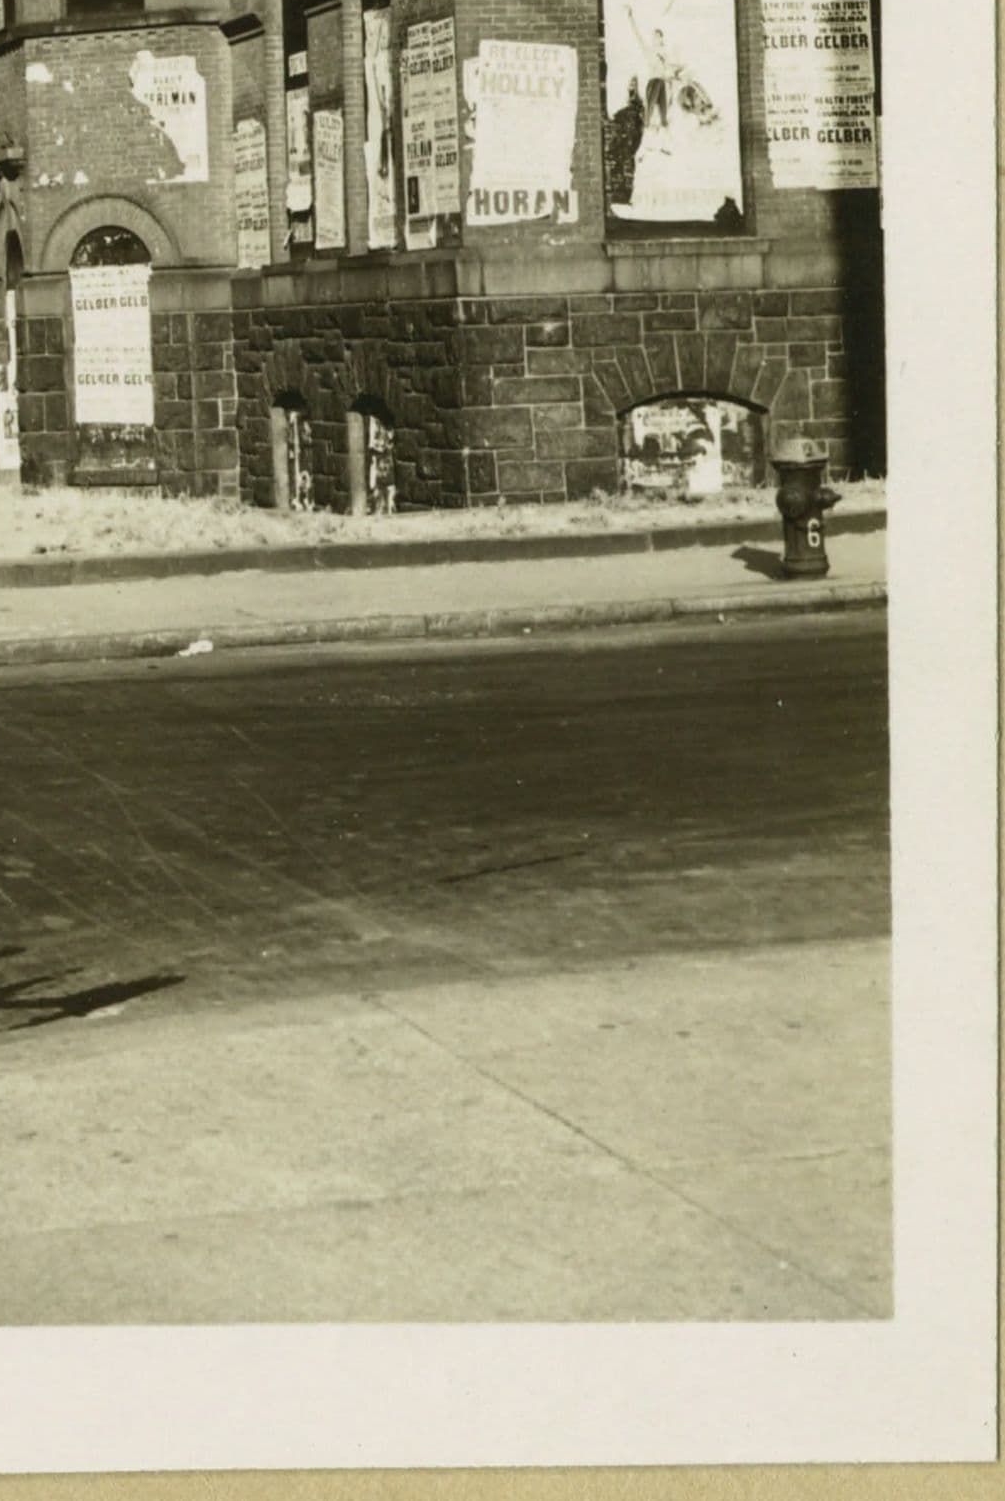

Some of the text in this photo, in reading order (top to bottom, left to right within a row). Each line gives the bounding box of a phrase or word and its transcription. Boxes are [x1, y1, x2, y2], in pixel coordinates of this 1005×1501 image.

[814, 33, 869, 49] GELBER
[480, 72, 565, 98] HOLLEY
[817, 128, 872, 144] GELBER
[474, 188, 570, 216] HORAN
[807, 518, 821, 548] 6
